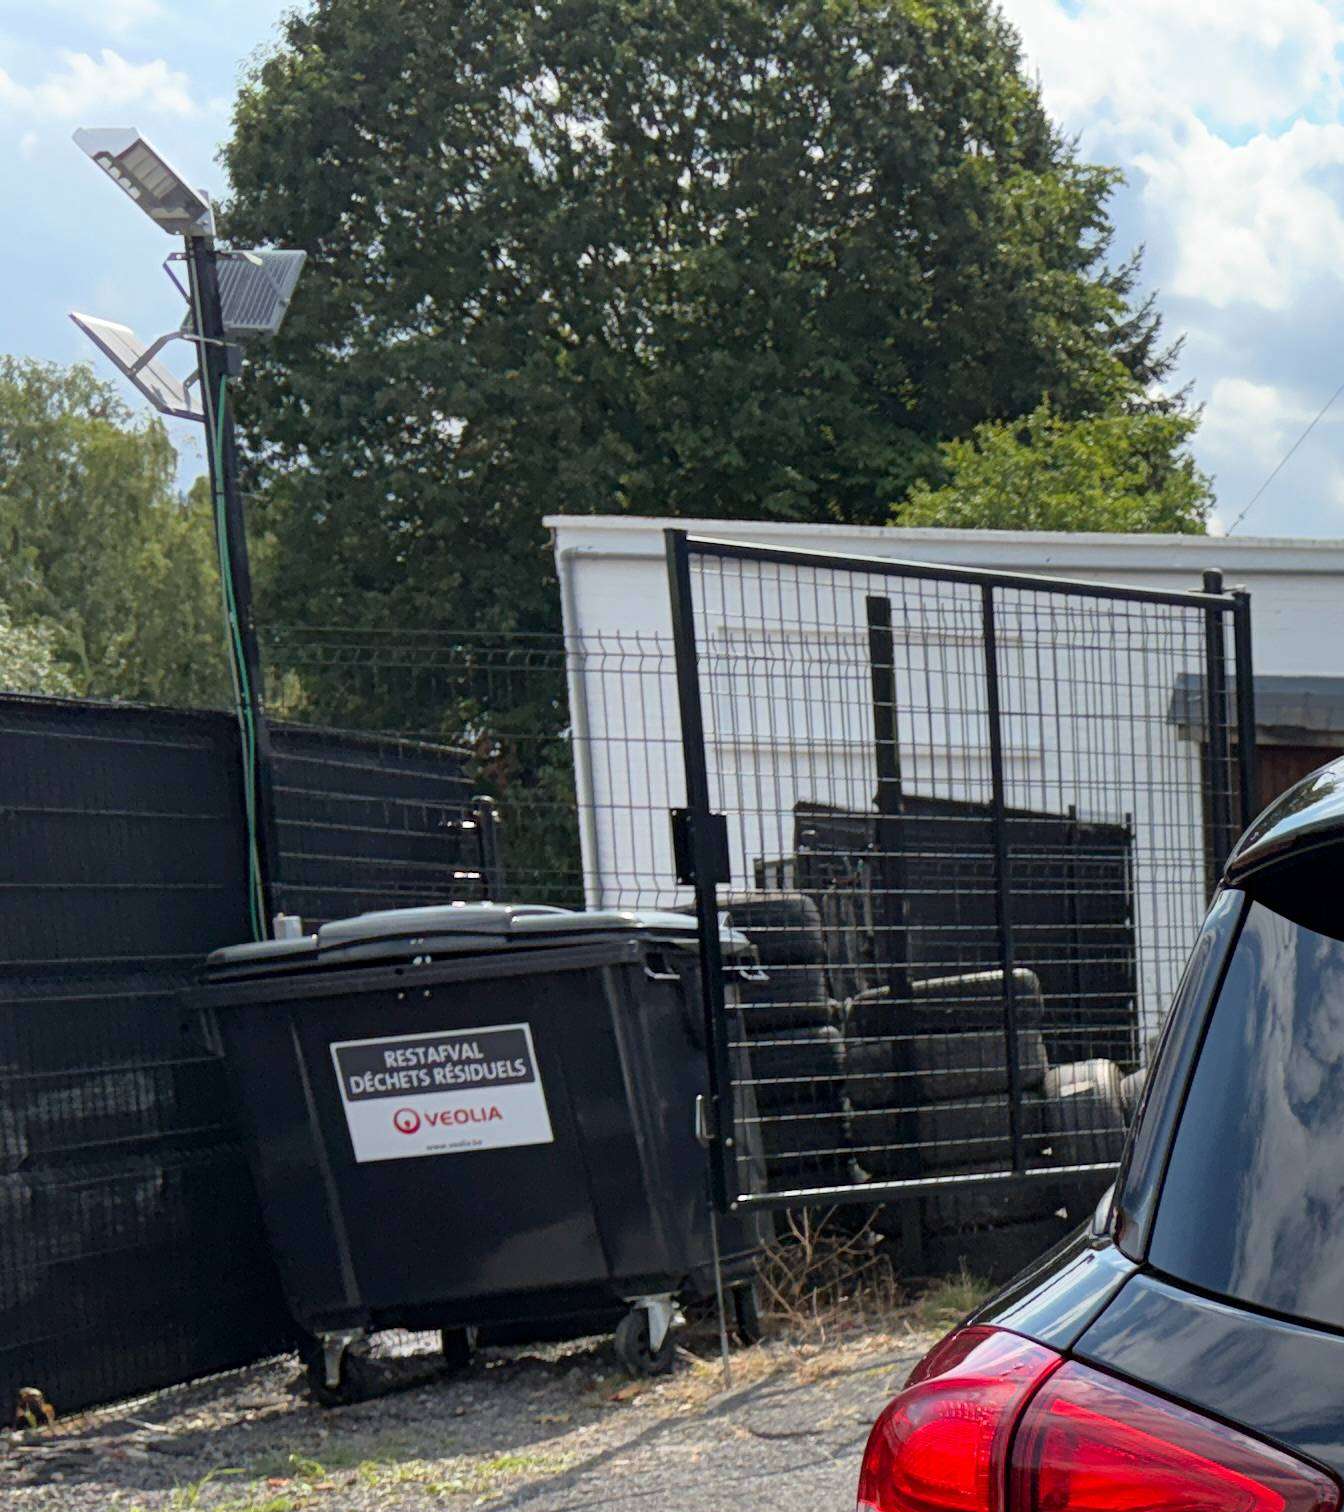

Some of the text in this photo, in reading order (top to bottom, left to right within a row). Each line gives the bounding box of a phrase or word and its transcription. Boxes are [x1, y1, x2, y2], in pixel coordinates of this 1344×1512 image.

[383, 1041, 484, 1069] RESTAFVAL
[350, 1058, 527, 1095] DÉCHETS RÉSIDUELS
[424, 1106, 503, 1127] VEOLIA
